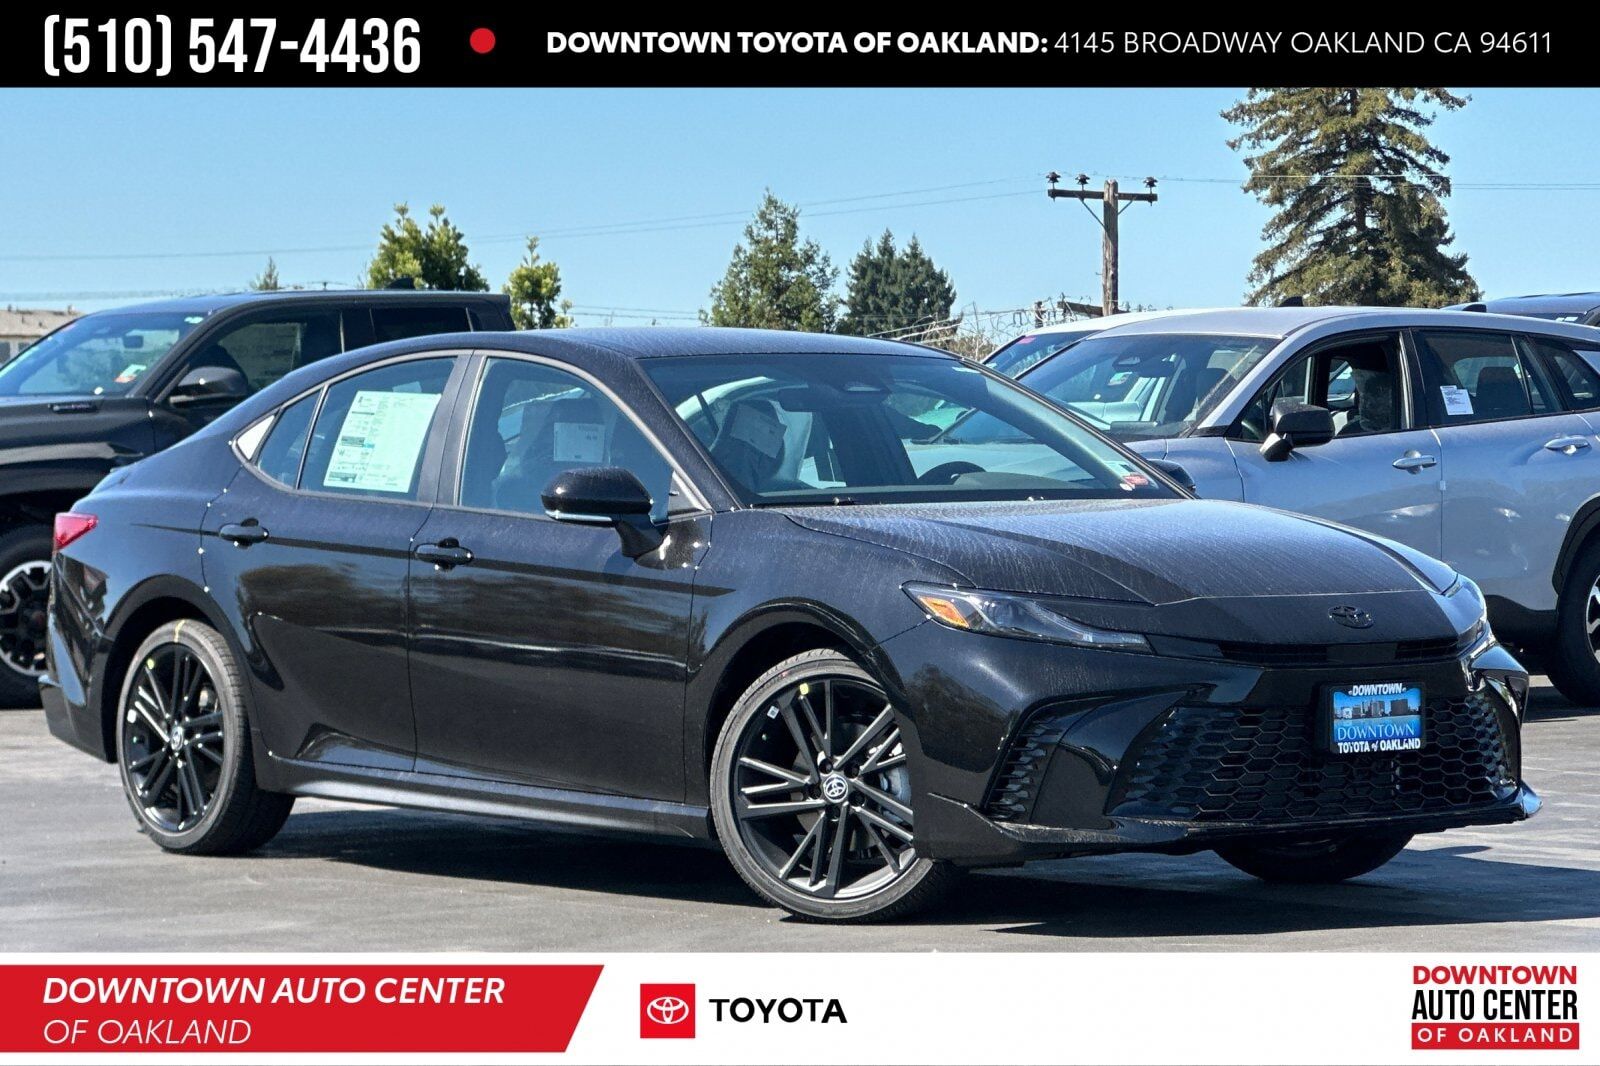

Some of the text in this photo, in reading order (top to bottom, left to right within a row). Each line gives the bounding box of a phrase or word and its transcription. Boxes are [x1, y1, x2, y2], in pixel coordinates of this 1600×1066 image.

[1352, 682, 1403, 696] DOWNTOWN
[1337, 722, 1415, 741] DOWNTOWN
[1338, 738, 1421, 754] TOYOTA of OAKLAND
